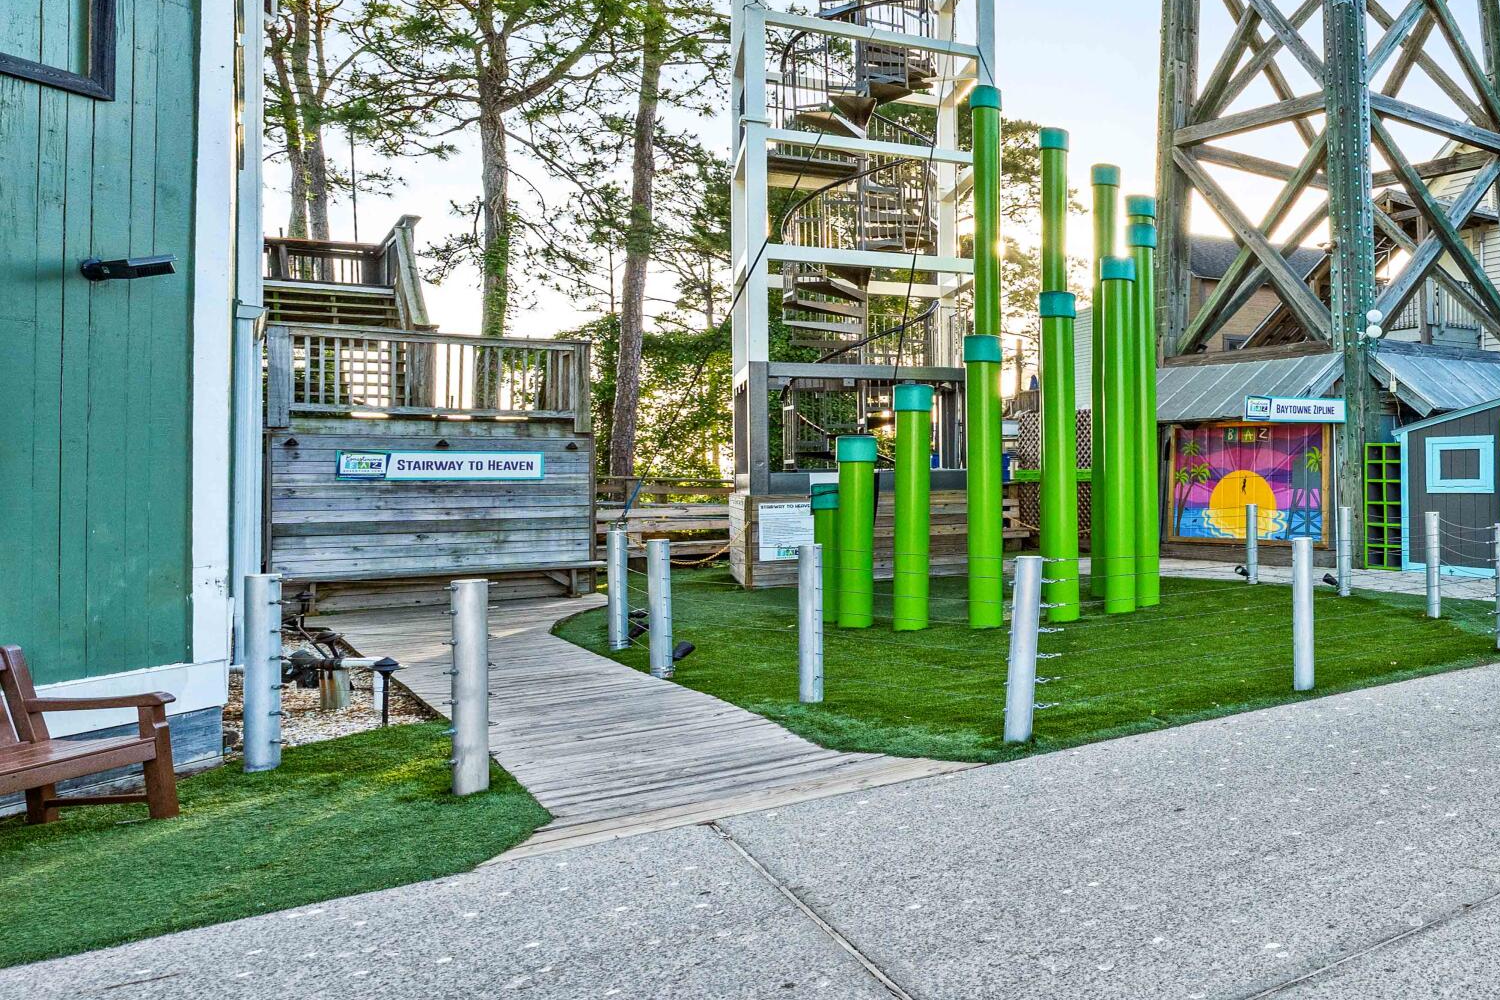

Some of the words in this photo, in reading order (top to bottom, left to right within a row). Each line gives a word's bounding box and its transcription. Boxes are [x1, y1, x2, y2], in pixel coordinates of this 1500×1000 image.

[1276, 403, 1311, 414] BAYTOWNE
[1313, 404, 1335, 415] ZIPLINE
[397, 459, 464, 471] STAIRWAY
[469, 460, 483, 471] TO
[488, 460, 534, 471] HEAVEN
